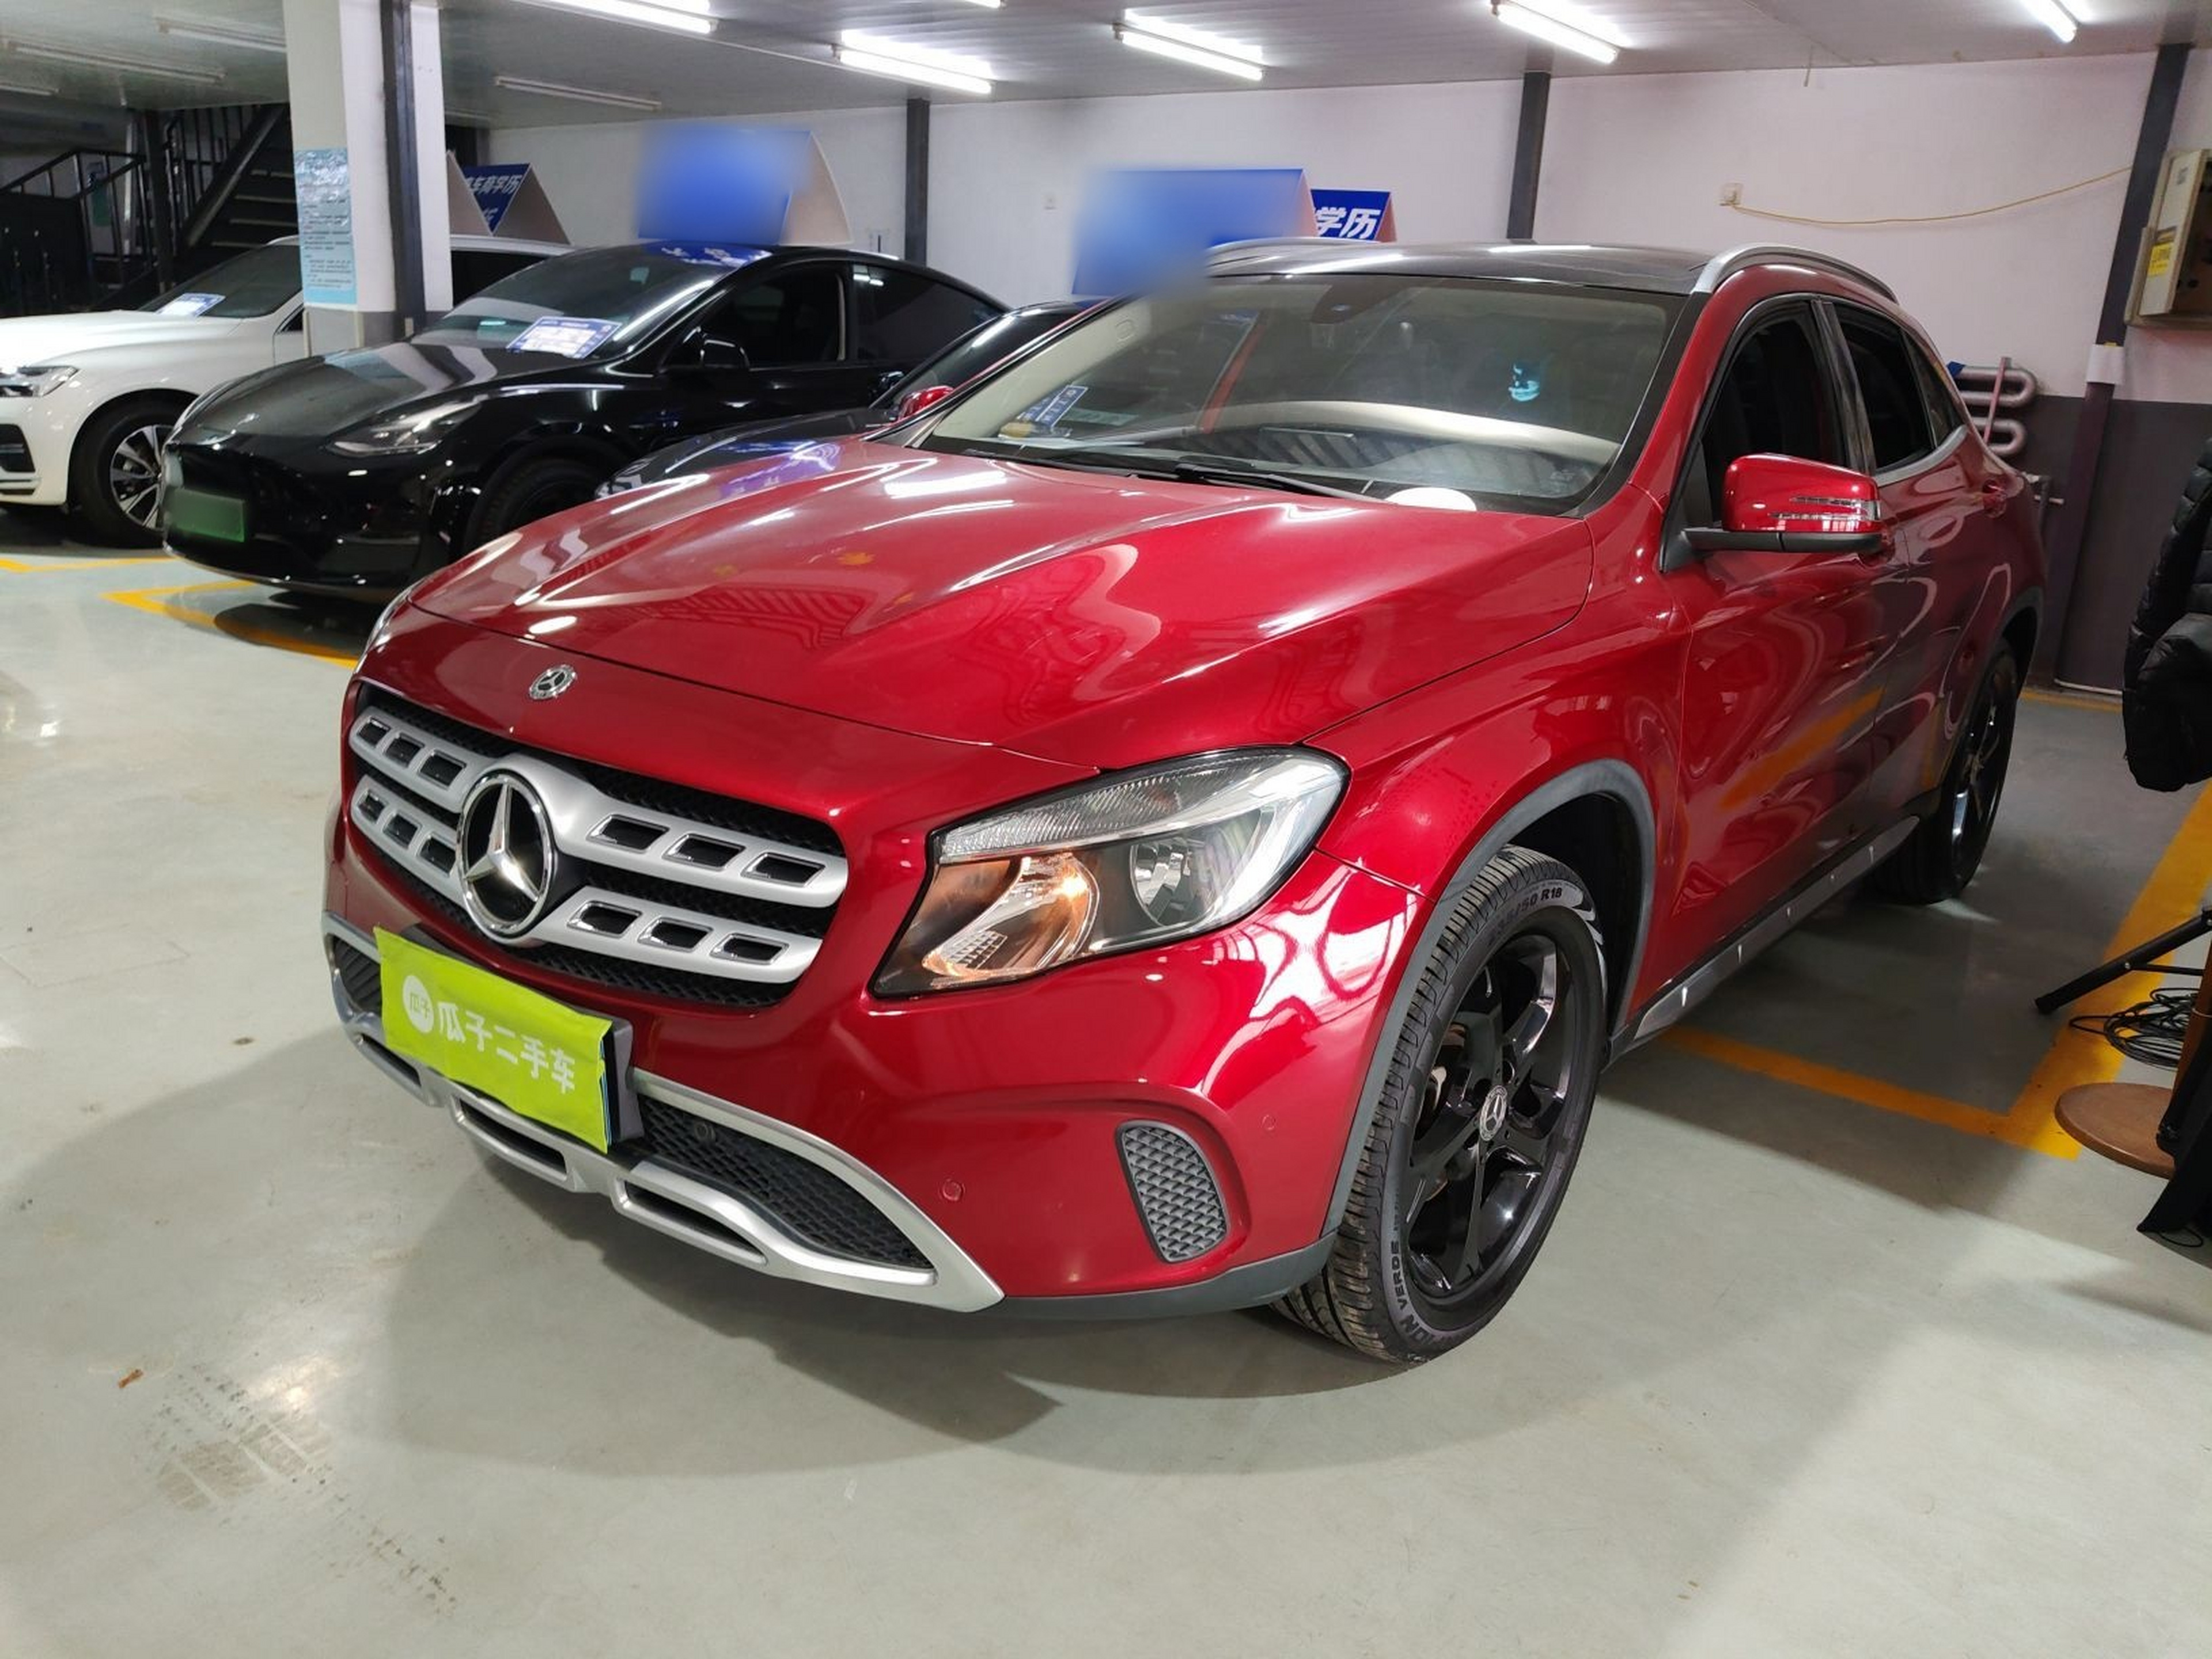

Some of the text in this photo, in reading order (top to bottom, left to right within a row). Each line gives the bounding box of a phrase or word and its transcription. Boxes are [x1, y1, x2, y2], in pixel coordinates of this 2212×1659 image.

[1315, 206, 1381, 239] 学历
[1540, 887, 1562, 902] R18
[437, 1001, 575, 1094] 瓜子二手车
[1391, 1240, 1408, 1310] VERDE
